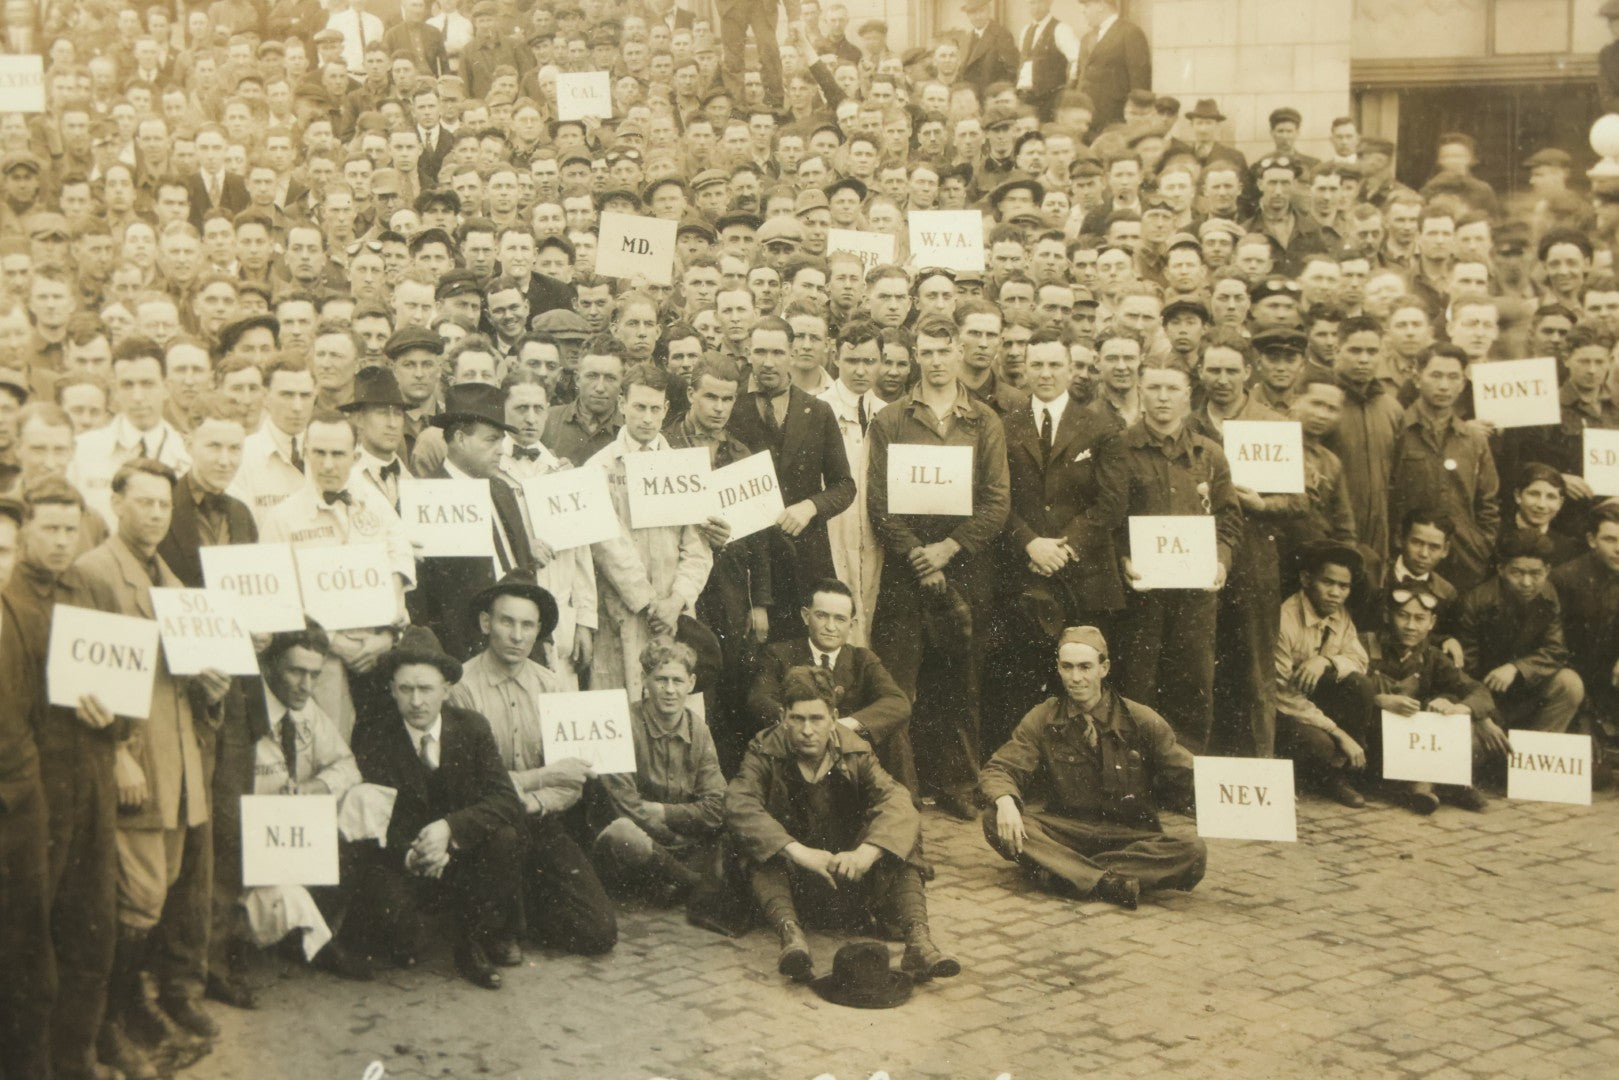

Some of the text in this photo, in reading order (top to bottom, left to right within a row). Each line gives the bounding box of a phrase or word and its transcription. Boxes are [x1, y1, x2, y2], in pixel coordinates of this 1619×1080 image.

[621, 235, 654, 256] MD.
[1482, 379, 1548, 400] MONT.
[1237, 443, 1290, 462] ARIZ.
[642, 473, 707, 496] MASS.
[910, 466, 953, 485] ILL.
[717, 474, 778, 509] IDAHO.
[416, 503, 484, 524] KANS.
[548, 492, 587, 516] N.Y.
[1155, 535, 1190, 554] PA.
[220, 573, 278, 596] OHIO
[178, 592, 215, 614] SO.
[163, 616, 245, 638] AFRICA
[71, 638, 148, 672] CONN.
[554, 719, 623, 742] ALAS.
[1408, 731, 1442, 752] P.I.
[1509, 751, 1584, 776] HAWAII
[1219, 783, 1272, 807] NEV.
[266, 825, 312, 848] N.H.
